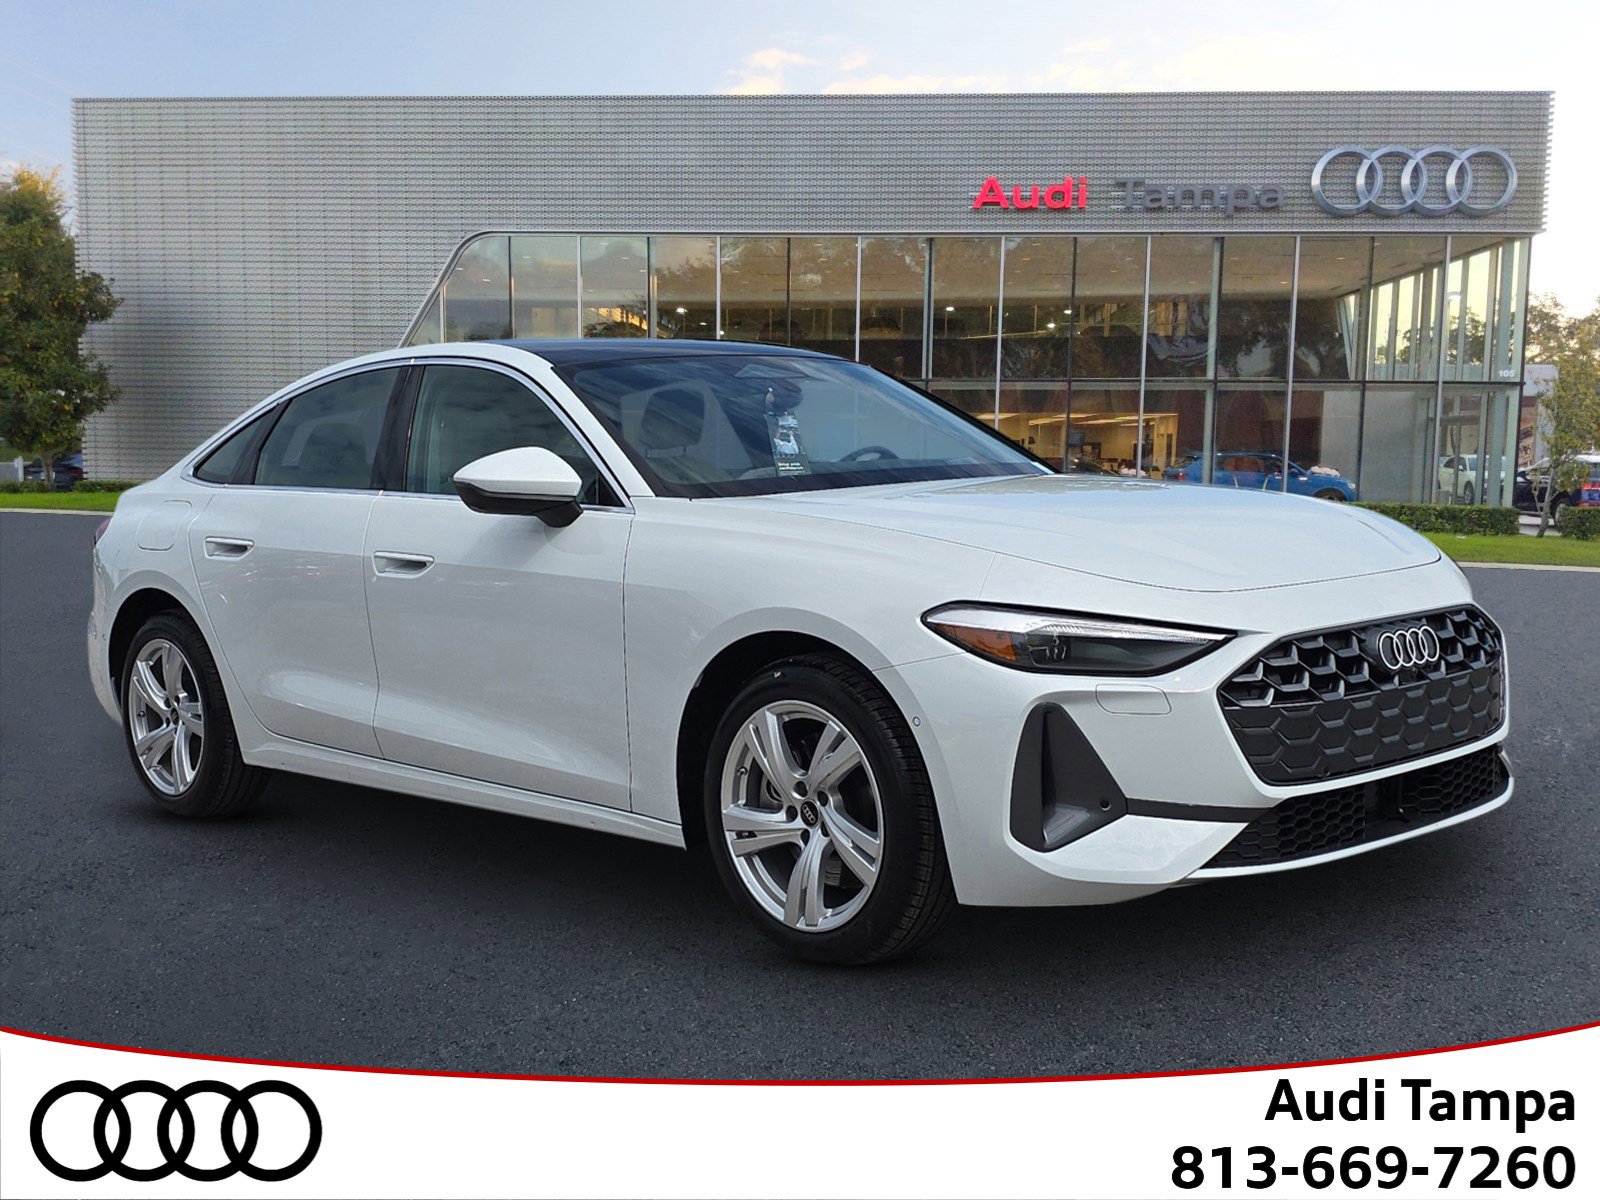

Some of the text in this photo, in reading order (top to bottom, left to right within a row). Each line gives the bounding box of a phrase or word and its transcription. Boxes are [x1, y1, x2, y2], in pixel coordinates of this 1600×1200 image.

[973, 176, 1286, 217] Audi Tampa
[1498, 370, 1515, 378] 105
